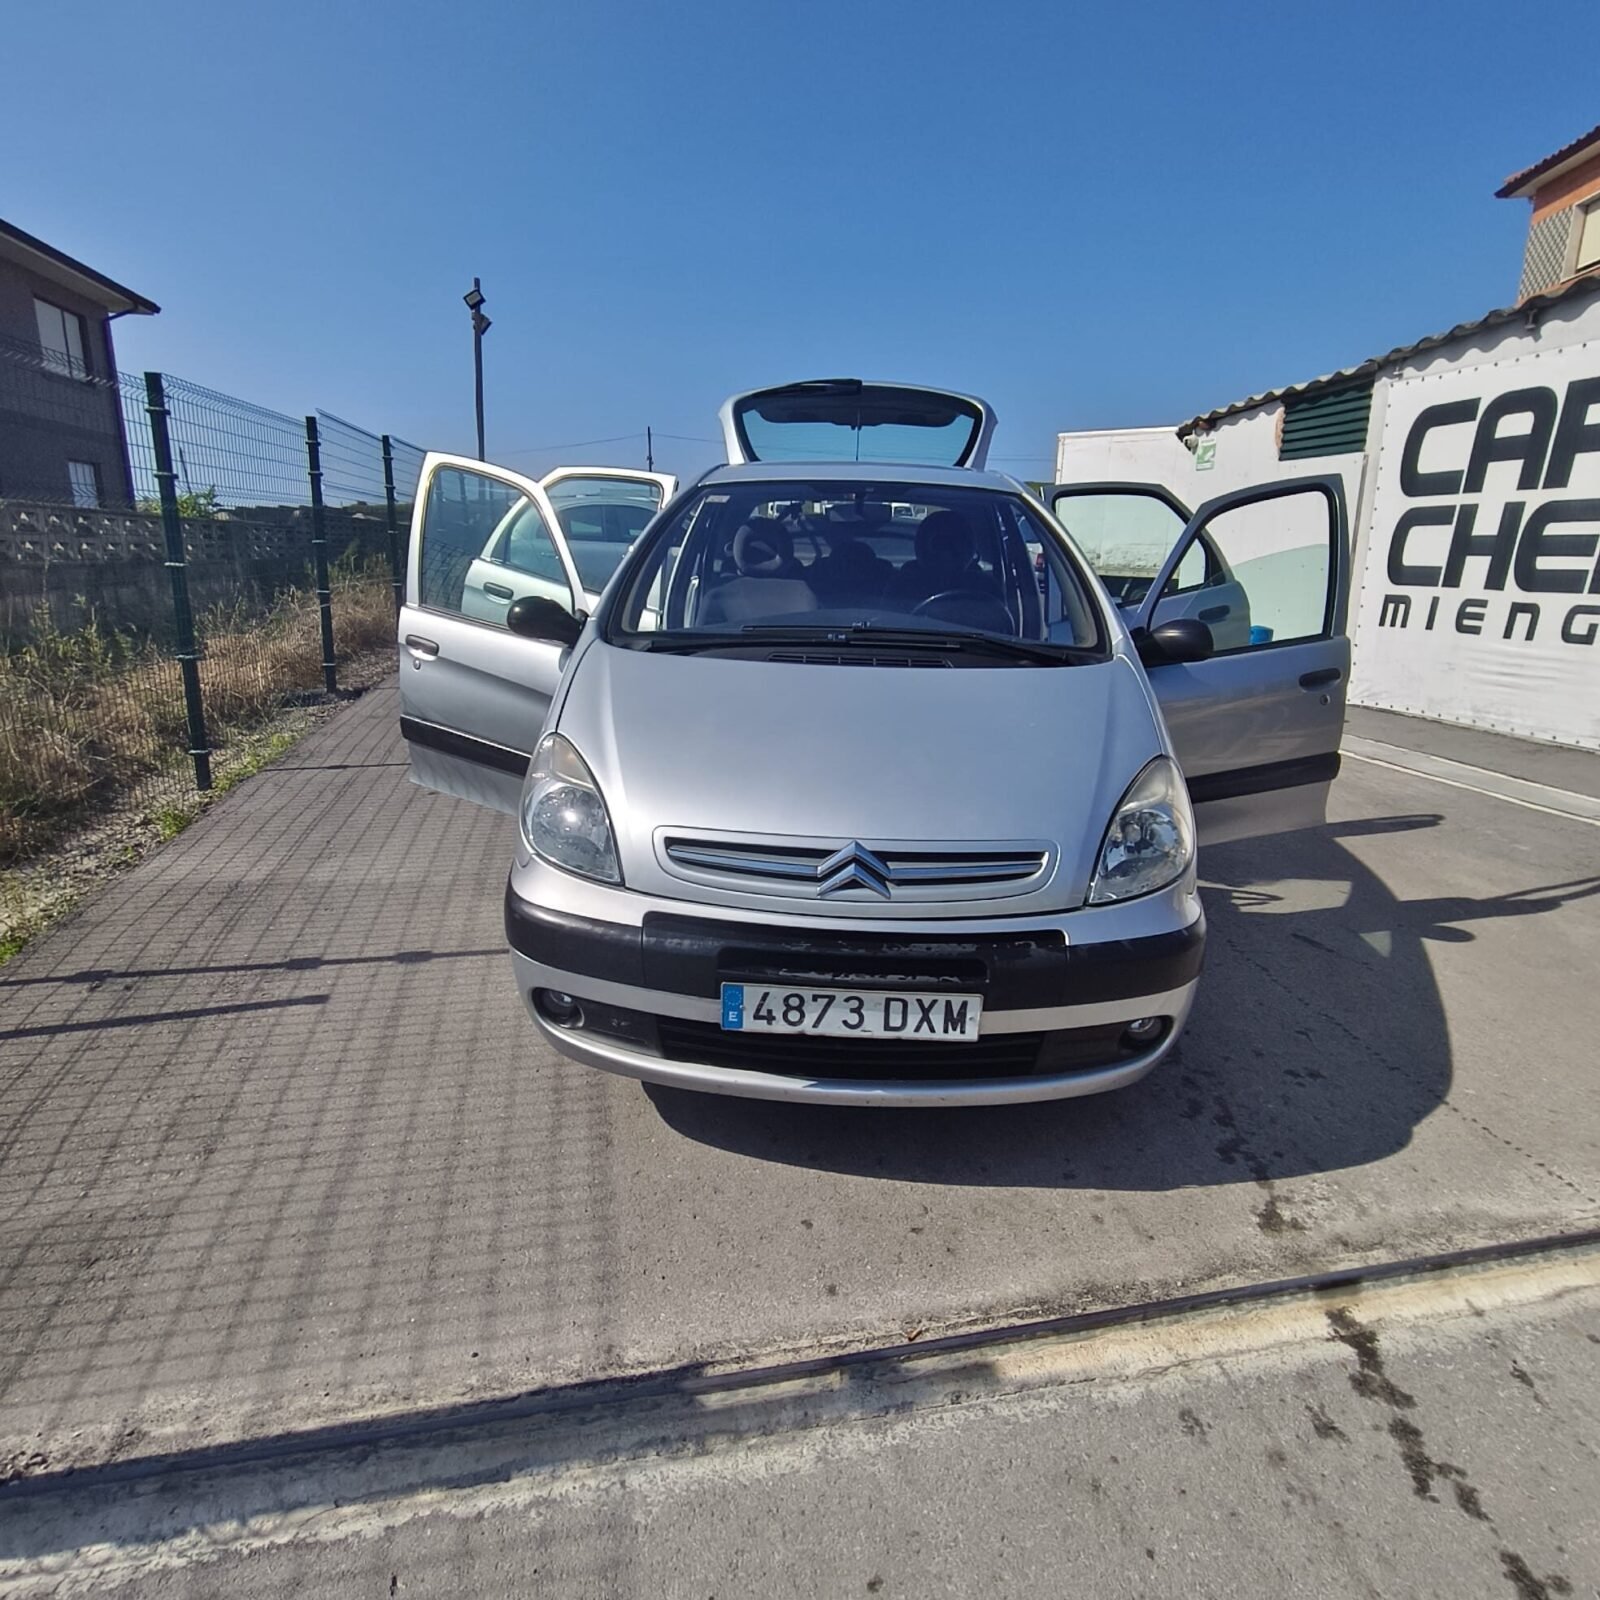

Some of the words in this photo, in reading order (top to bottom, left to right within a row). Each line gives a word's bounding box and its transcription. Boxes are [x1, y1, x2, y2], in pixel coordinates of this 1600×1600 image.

[1387, 498, 1600, 595] CHE
[728, 1011, 738, 1022] E
[752, 991, 865, 1030] 4873
[883, 996, 969, 1035] DXM
